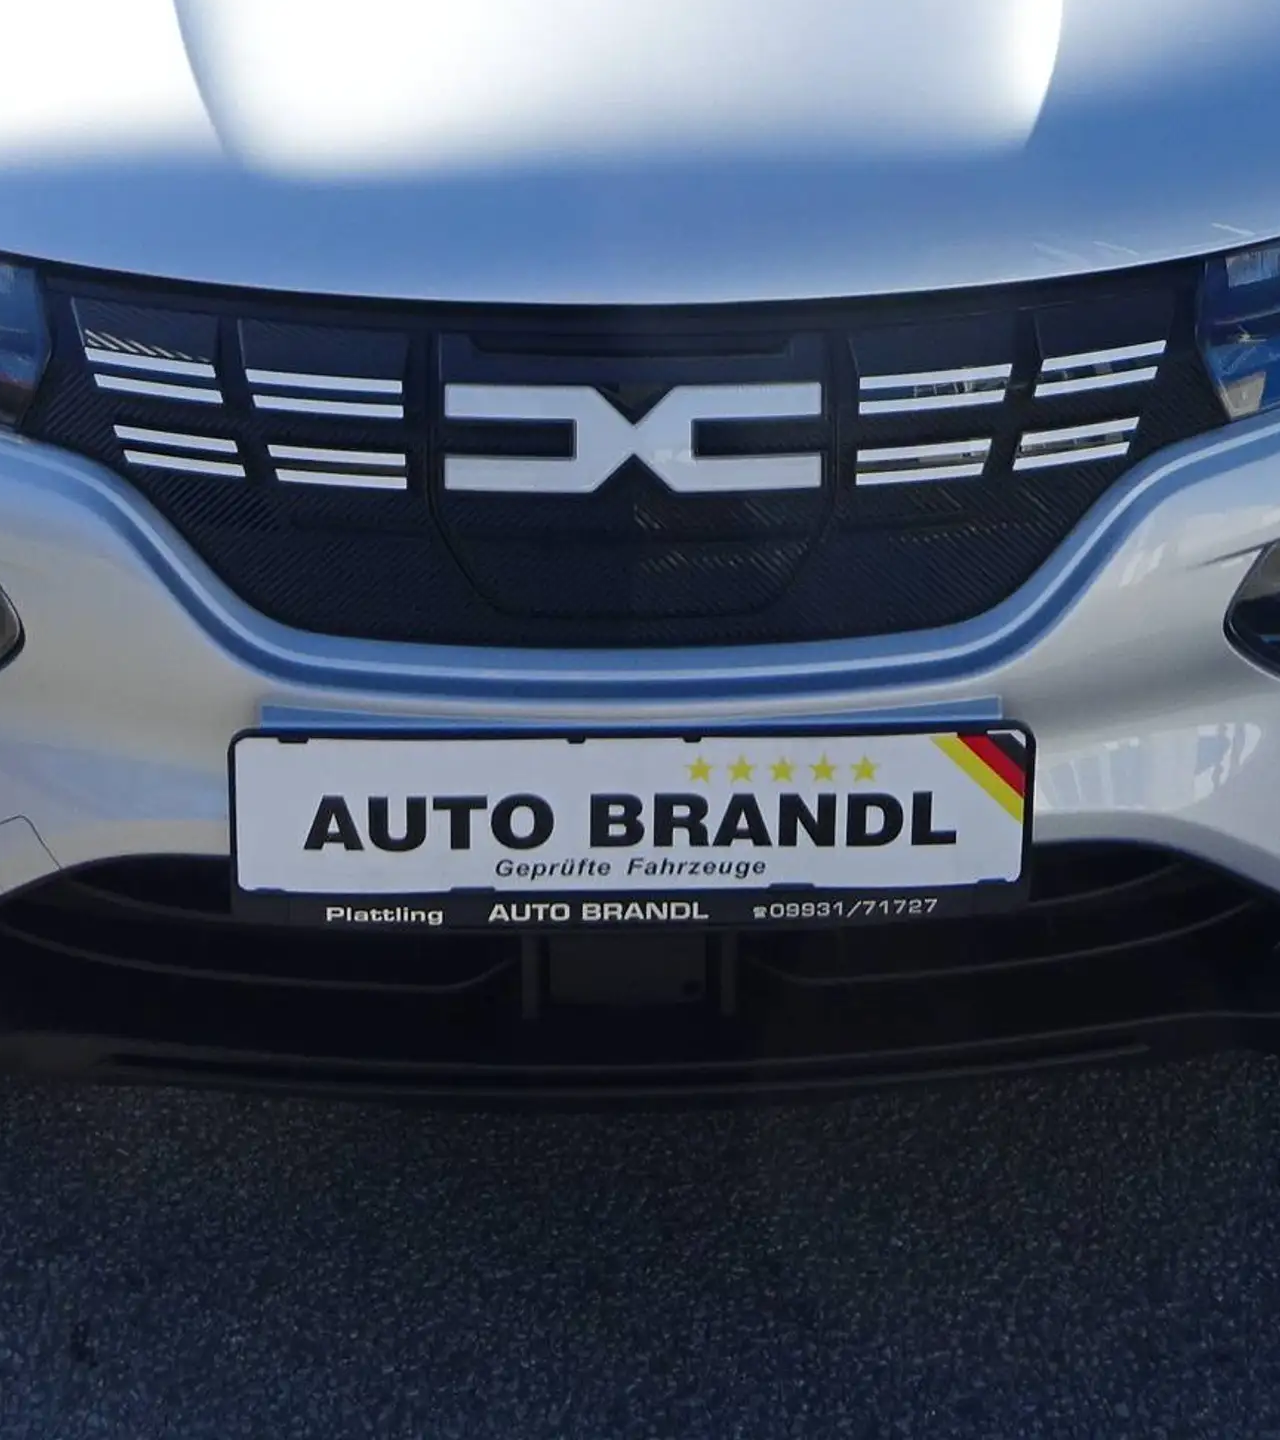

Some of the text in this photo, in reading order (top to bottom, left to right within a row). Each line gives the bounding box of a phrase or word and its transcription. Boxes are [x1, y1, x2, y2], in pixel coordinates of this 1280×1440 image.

[303, 791, 957, 852] AUTO BRANDL
[495, 857, 767, 880] Geprüfte Fahrzeuge
[325, 906, 445, 926] Plattling
[488, 903, 570, 922] AUTO
[581, 902, 709, 921] BRANDL
